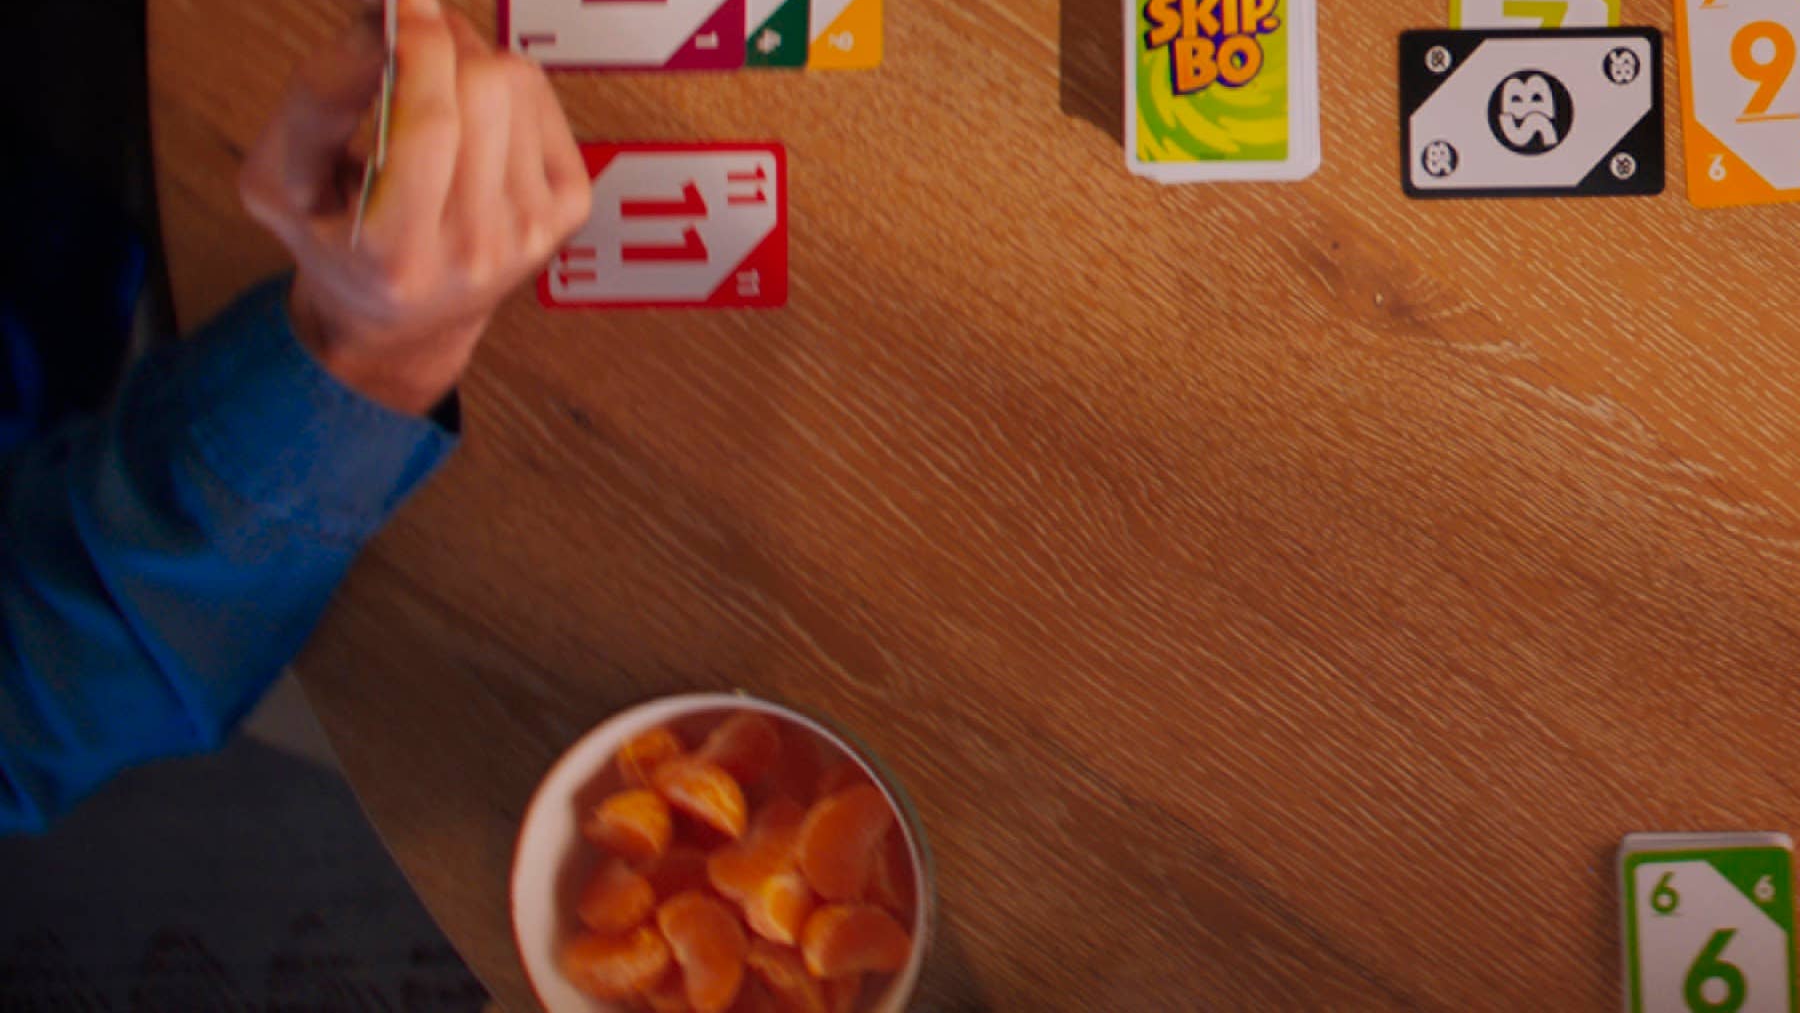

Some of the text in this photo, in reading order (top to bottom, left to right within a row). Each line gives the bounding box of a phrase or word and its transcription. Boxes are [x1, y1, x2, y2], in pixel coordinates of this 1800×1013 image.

[518, 33, 556, 51] 1
[1169, 34, 1264, 97] BO
[1730, 20, 1798, 118] 9
[1499, 74, 1558, 146] SB
[727, 163, 767, 205] 11
[620, 178, 708, 264] 11
[558, 247, 597, 288] 11
[1652, 871, 1680, 915] 6
[1753, 875, 1775, 902] 6
[1683, 927, 1746, 1013] 6
